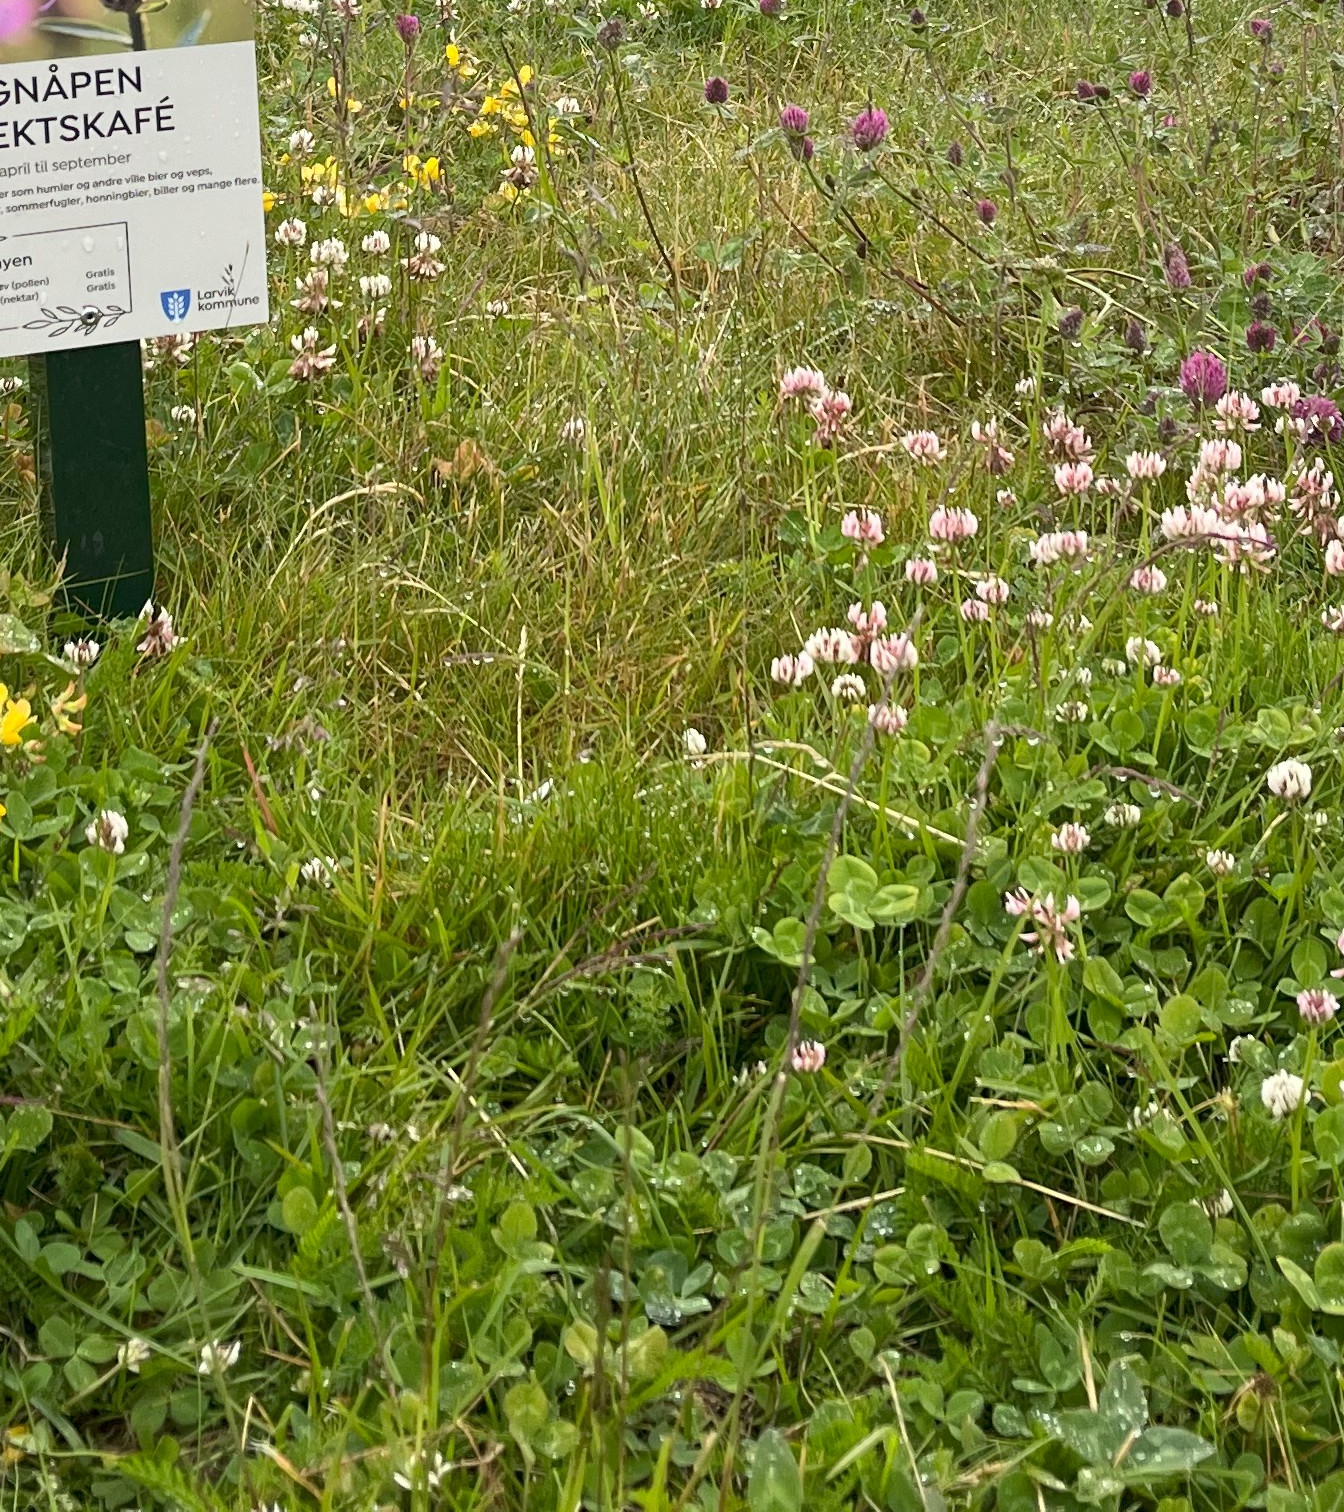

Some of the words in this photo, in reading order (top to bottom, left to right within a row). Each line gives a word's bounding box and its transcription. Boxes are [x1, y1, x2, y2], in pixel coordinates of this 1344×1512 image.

[0, 162, 30, 178] april
[35, 160, 48, 173] til
[52, 153, 131, 172] september
[12, 187, 34, 197] som
[37, 182, 73, 193] humler
[76, 181, 89, 192] og
[92, 177, 123, 187] andre
[125, 174, 145, 184] ville
[148, 172, 168, 181] bier
[171, 171, 184, 180] og
[186, 168, 213, 178] veps,
[6, 197, 84, 214] sommerfugler,
[86, 188, 152, 204] honningbier,
[154, 185, 178, 195] biller
[181, 184, 195, 193] og
[197, 180, 232, 191] mange
[235, 176, 260, 186] flere.
[11, 276, 50, 291] (pollen)
[85, 268, 115, 279] Gratis
[0, 292, 40, 305] (nektar)
[86, 281, 116, 293] Gratis
[197, 286, 235, 300] Larvik
[198, 295, 260, 311] kommune
